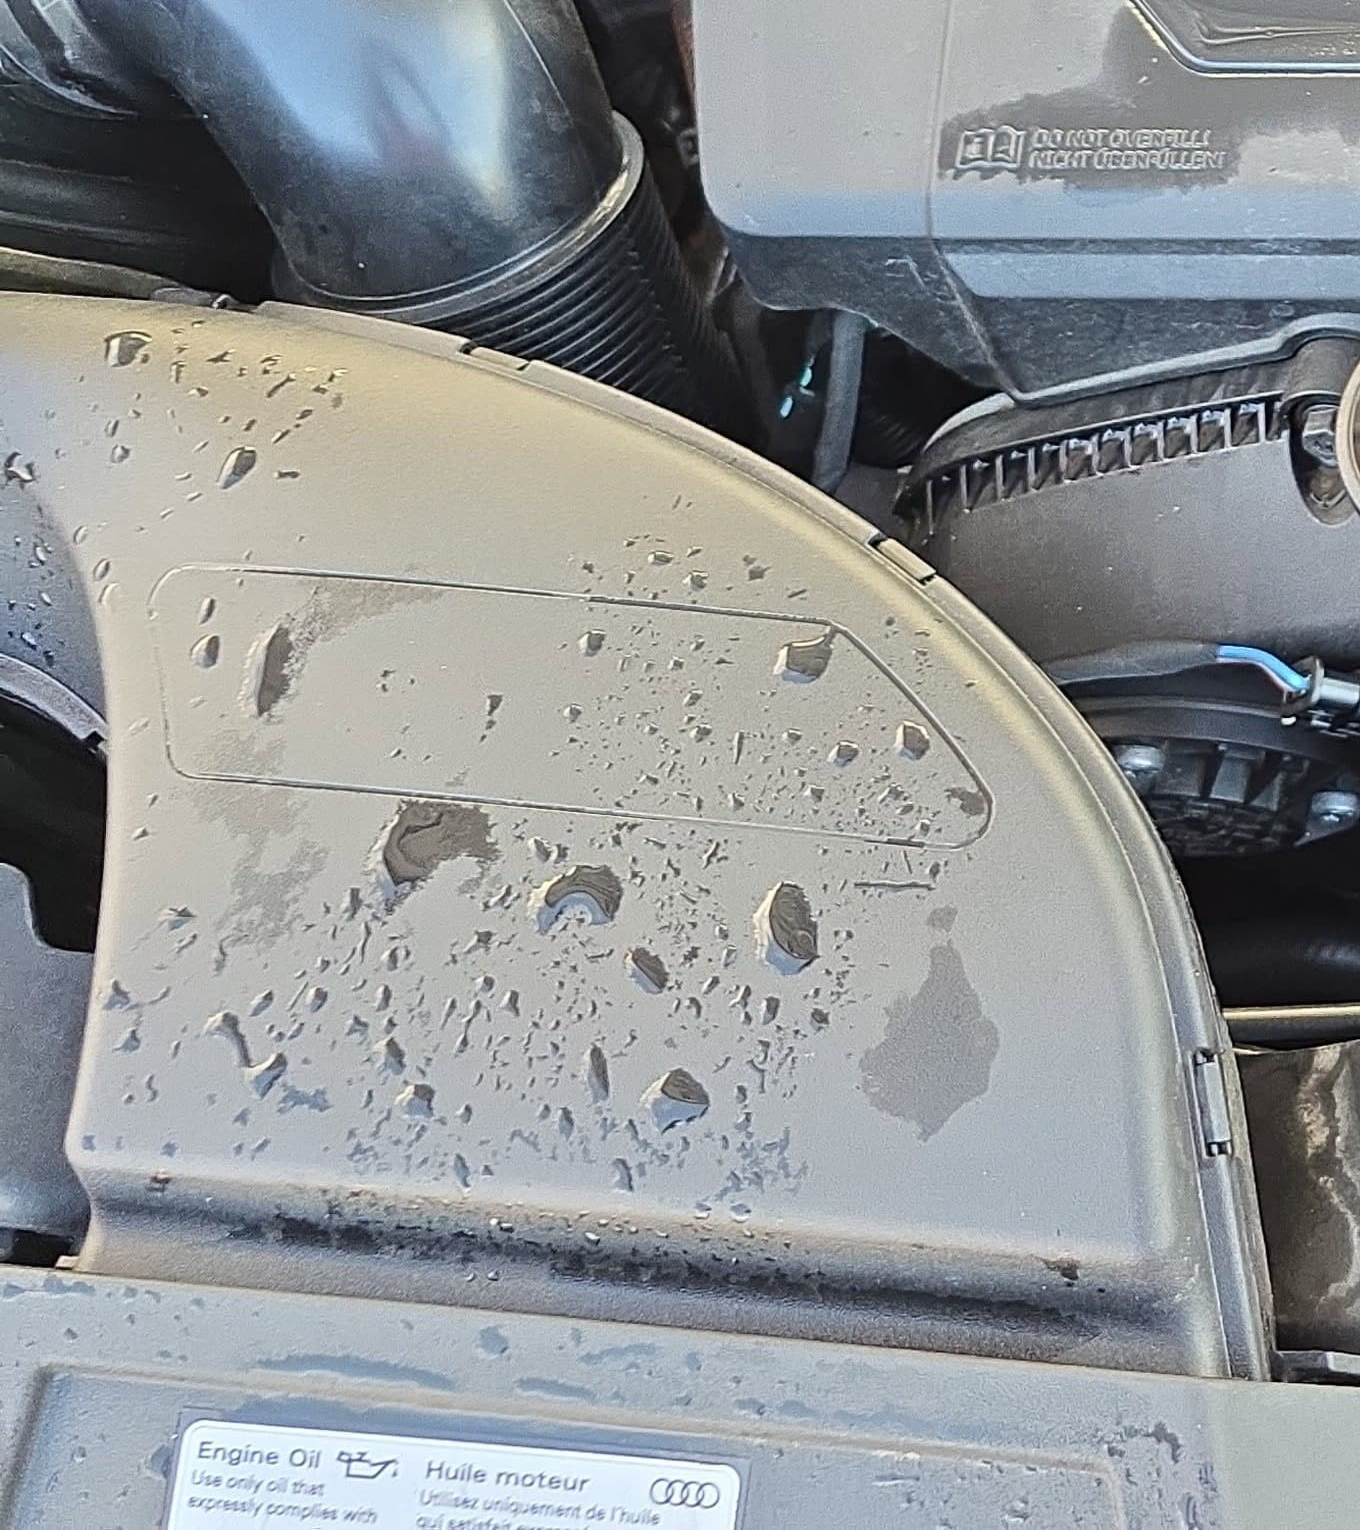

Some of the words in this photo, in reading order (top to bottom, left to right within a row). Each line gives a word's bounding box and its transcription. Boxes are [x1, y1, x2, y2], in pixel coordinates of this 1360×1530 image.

[1032, 128, 1064, 149] DO
[1065, 128, 1110, 149] NOT
[1028, 149, 1094, 169] NICHT
[196, 1440, 280, 1467] Engine
[289, 1448, 322, 1469] Oil
[425, 1460, 488, 1484] Huile
[495, 1470, 591, 1493] moteur
[191, 1469, 223, 1487] Use
[226, 1474, 264, 1495] only
[267, 1476, 290, 1493] oil
[291, 1479, 326, 1497] that
[187, 1495, 263, 1519] expressly
[266, 1500, 339, 1521] complies
[343, 1507, 379, 1525] with
[418, 1488, 480, 1511] Utilisez
[482, 1495, 582, 1519] uniquement
[585, 1505, 607, 1521] de
